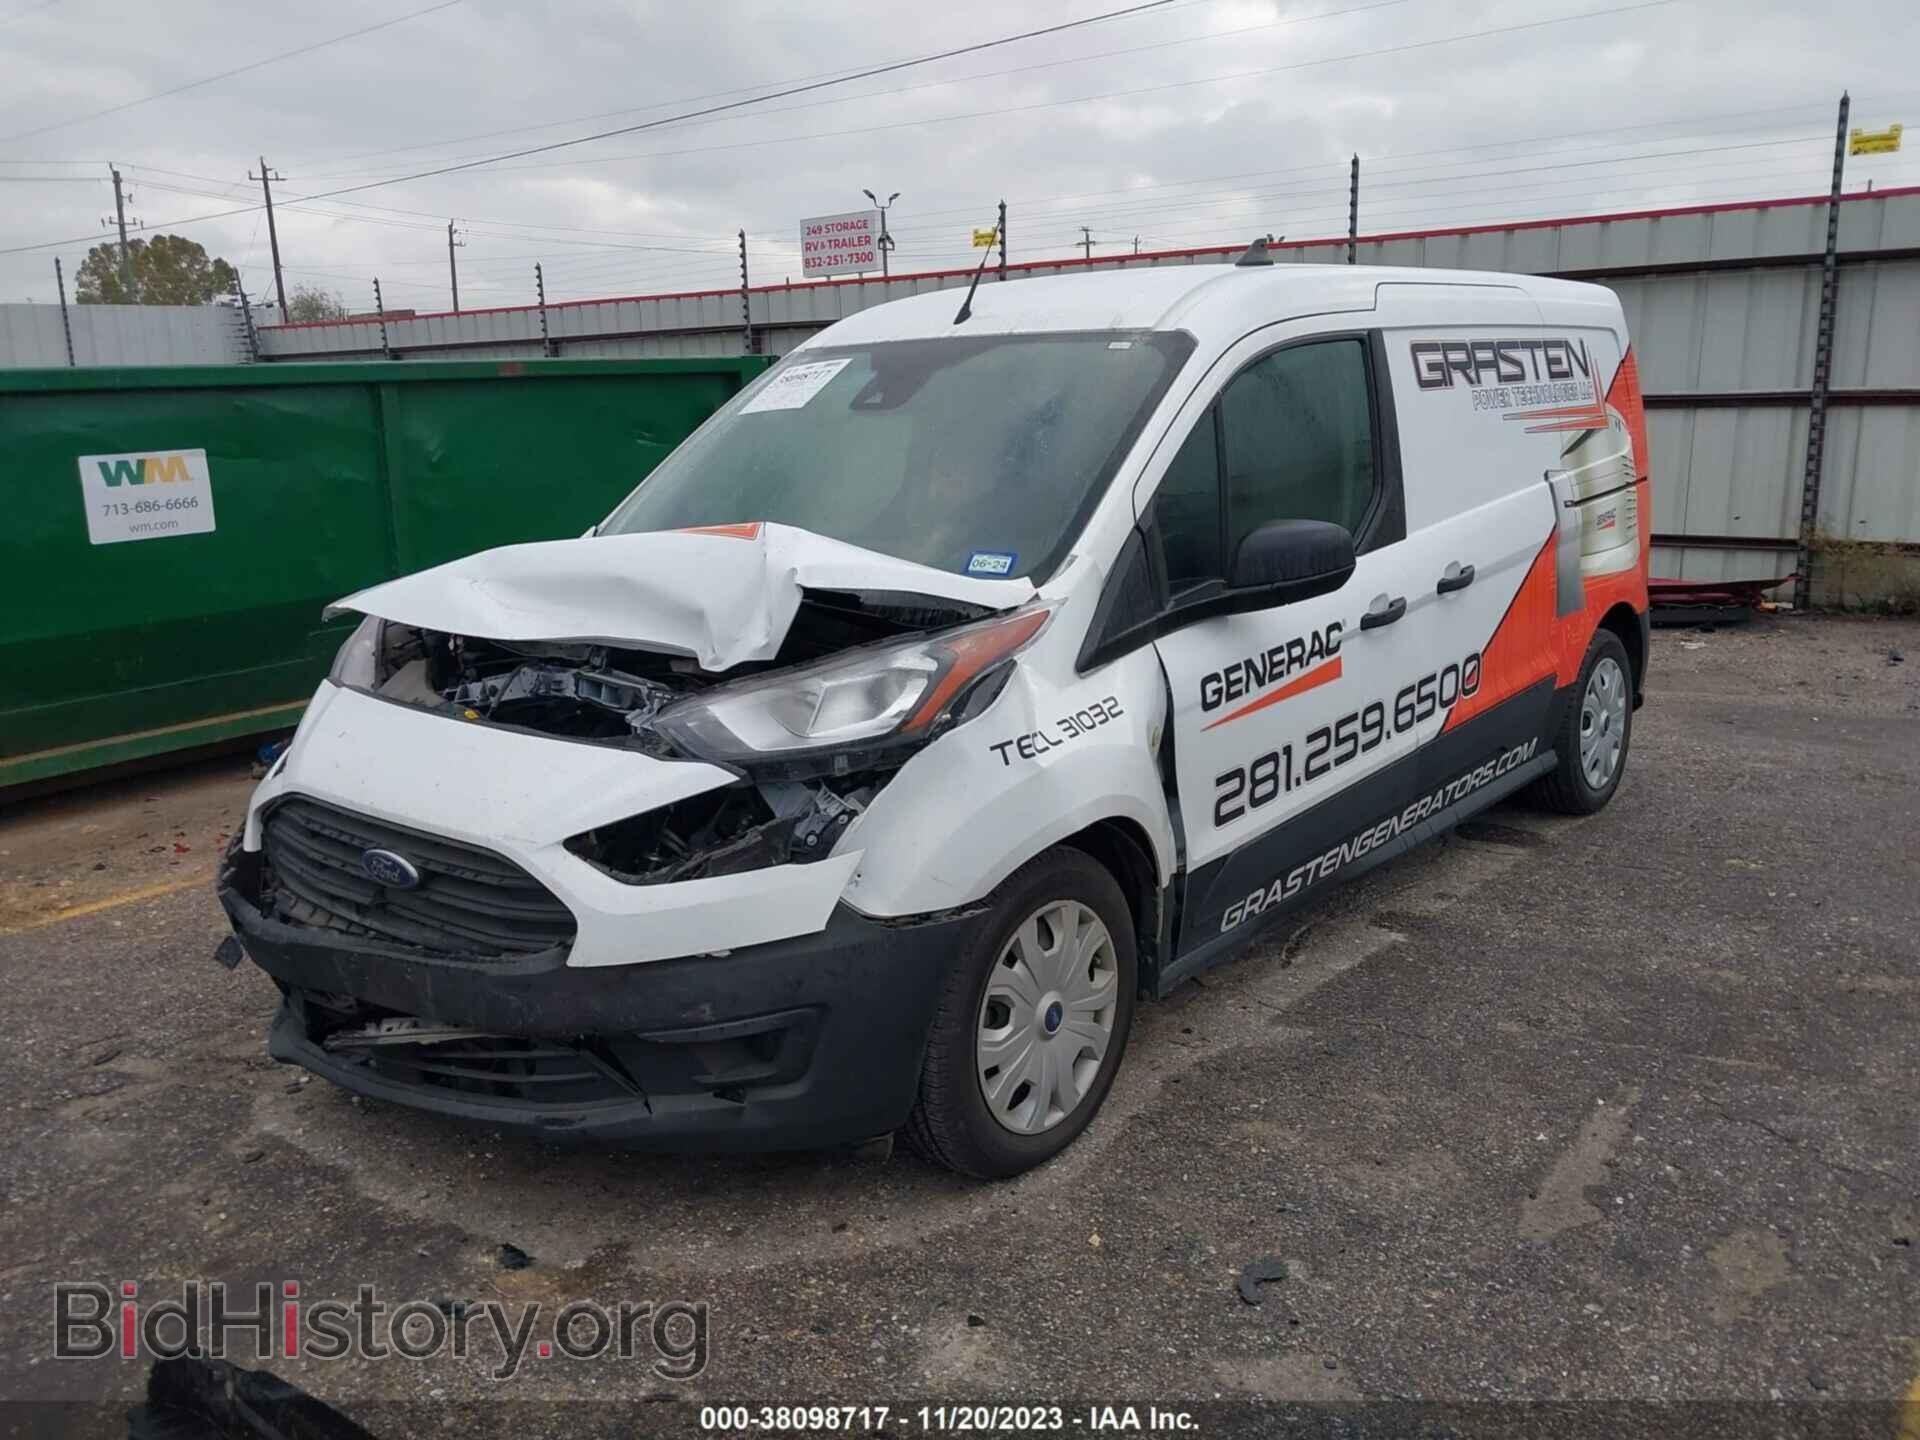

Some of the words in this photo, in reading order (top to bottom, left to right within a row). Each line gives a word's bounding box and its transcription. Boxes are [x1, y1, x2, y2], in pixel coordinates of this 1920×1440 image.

[805, 241, 819, 252] RV
[828, 235, 871, 249] TRAILER
[806, 225, 822, 236] 249
[824, 220, 868, 233] STORAGE
[805, 251, 874, 269] 832-251-7300
[1410, 338, 1589, 390] GRASTEN
[98, 455, 193, 487] WM
[103, 496, 199, 517] 713-686-6666
[129, 519, 178, 533] wm.com
[1200, 622, 1343, 712] GENERAC
[989, 729, 1063, 766] TECL
[1056, 695, 1124, 740] 31032
[1214, 652, 1481, 828] 281.259.6500
[1220, 737, 1538, 933] GRASTENGENERATORS.COM
